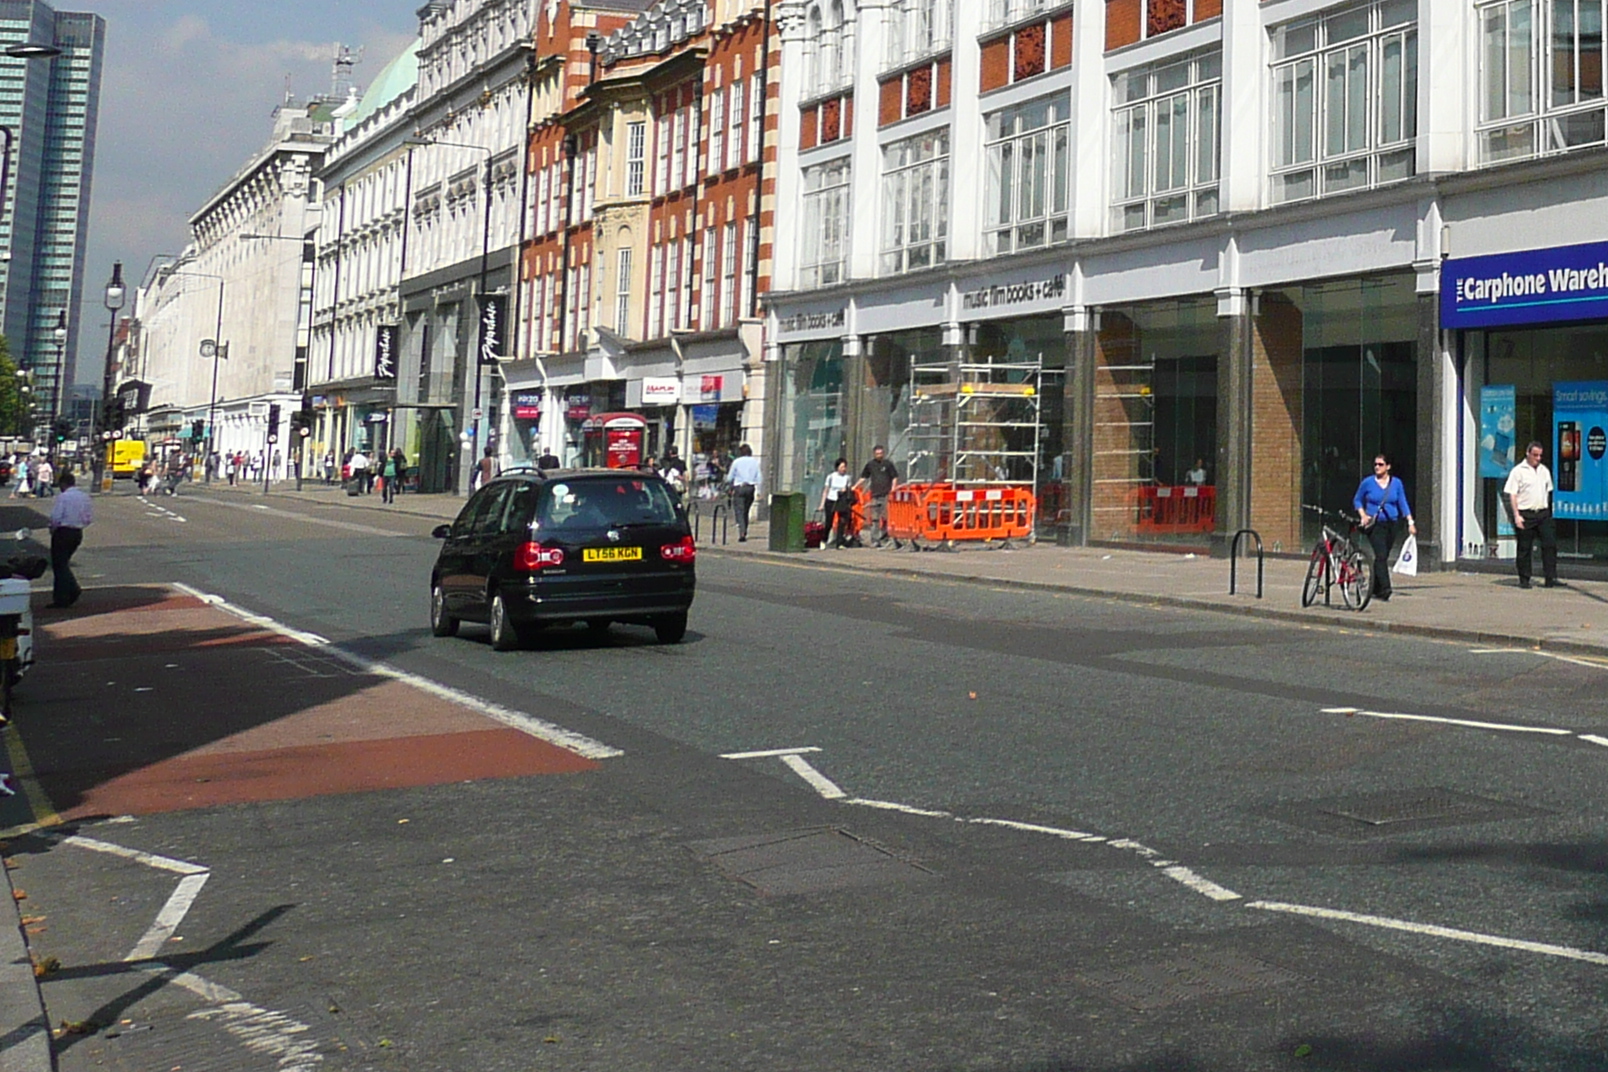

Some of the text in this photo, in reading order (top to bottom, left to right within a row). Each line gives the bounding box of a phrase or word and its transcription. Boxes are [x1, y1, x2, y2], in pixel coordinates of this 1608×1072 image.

[963, 286, 988, 309] music
[990, 284, 1006, 307] film
[1007, 280, 1034, 304] books
[1464, 272, 1546, 303] Carphone
[588, 548, 638, 560] LT56 KGN
